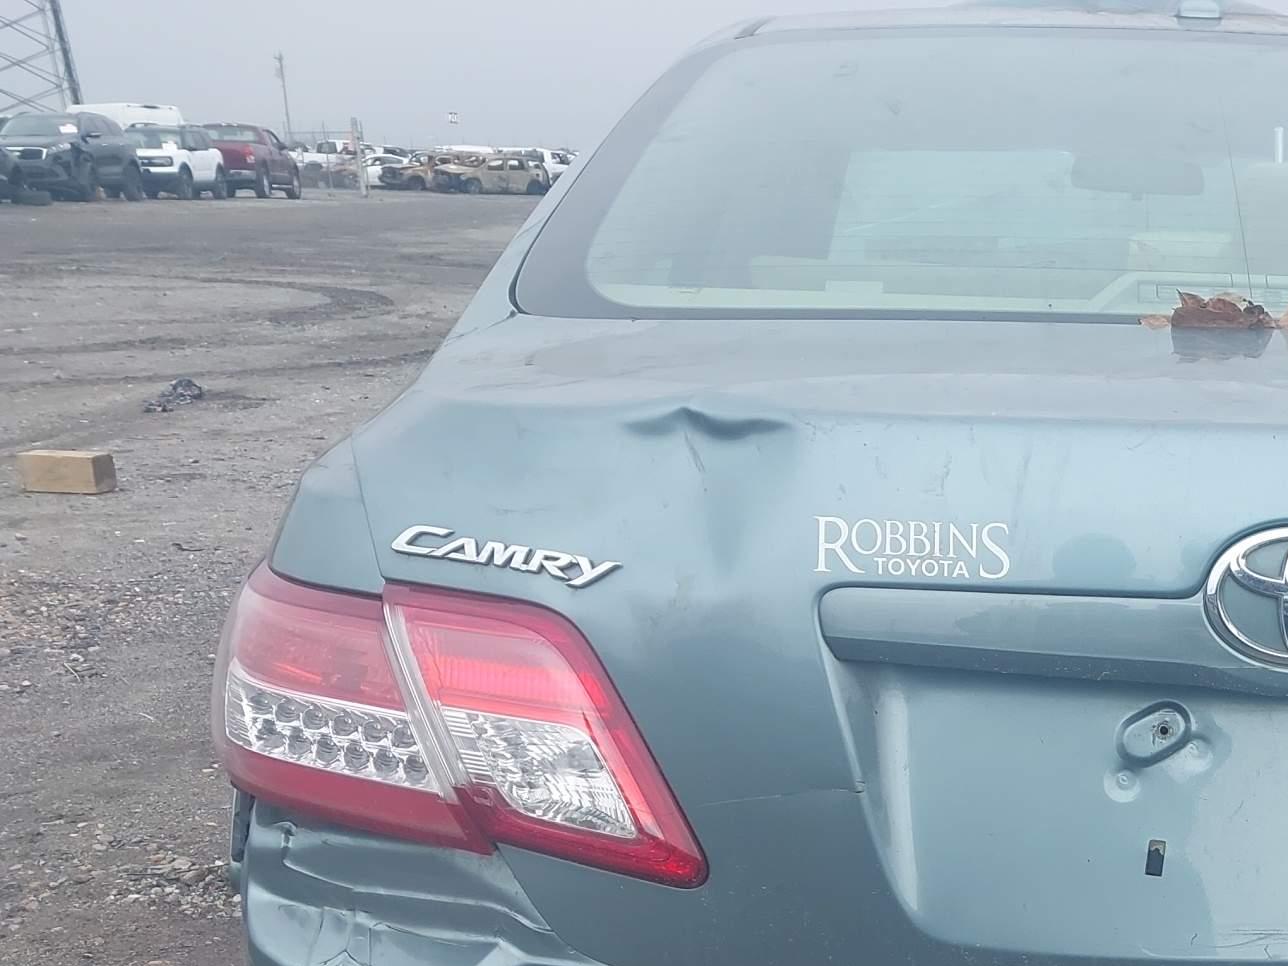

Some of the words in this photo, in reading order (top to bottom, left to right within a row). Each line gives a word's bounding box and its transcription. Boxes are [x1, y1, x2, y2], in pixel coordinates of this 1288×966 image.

[391, 525, 624, 589] CAMRY
[812, 515, 1011, 579] ROBBINS
[873, 557, 970, 578] TOYOTA
